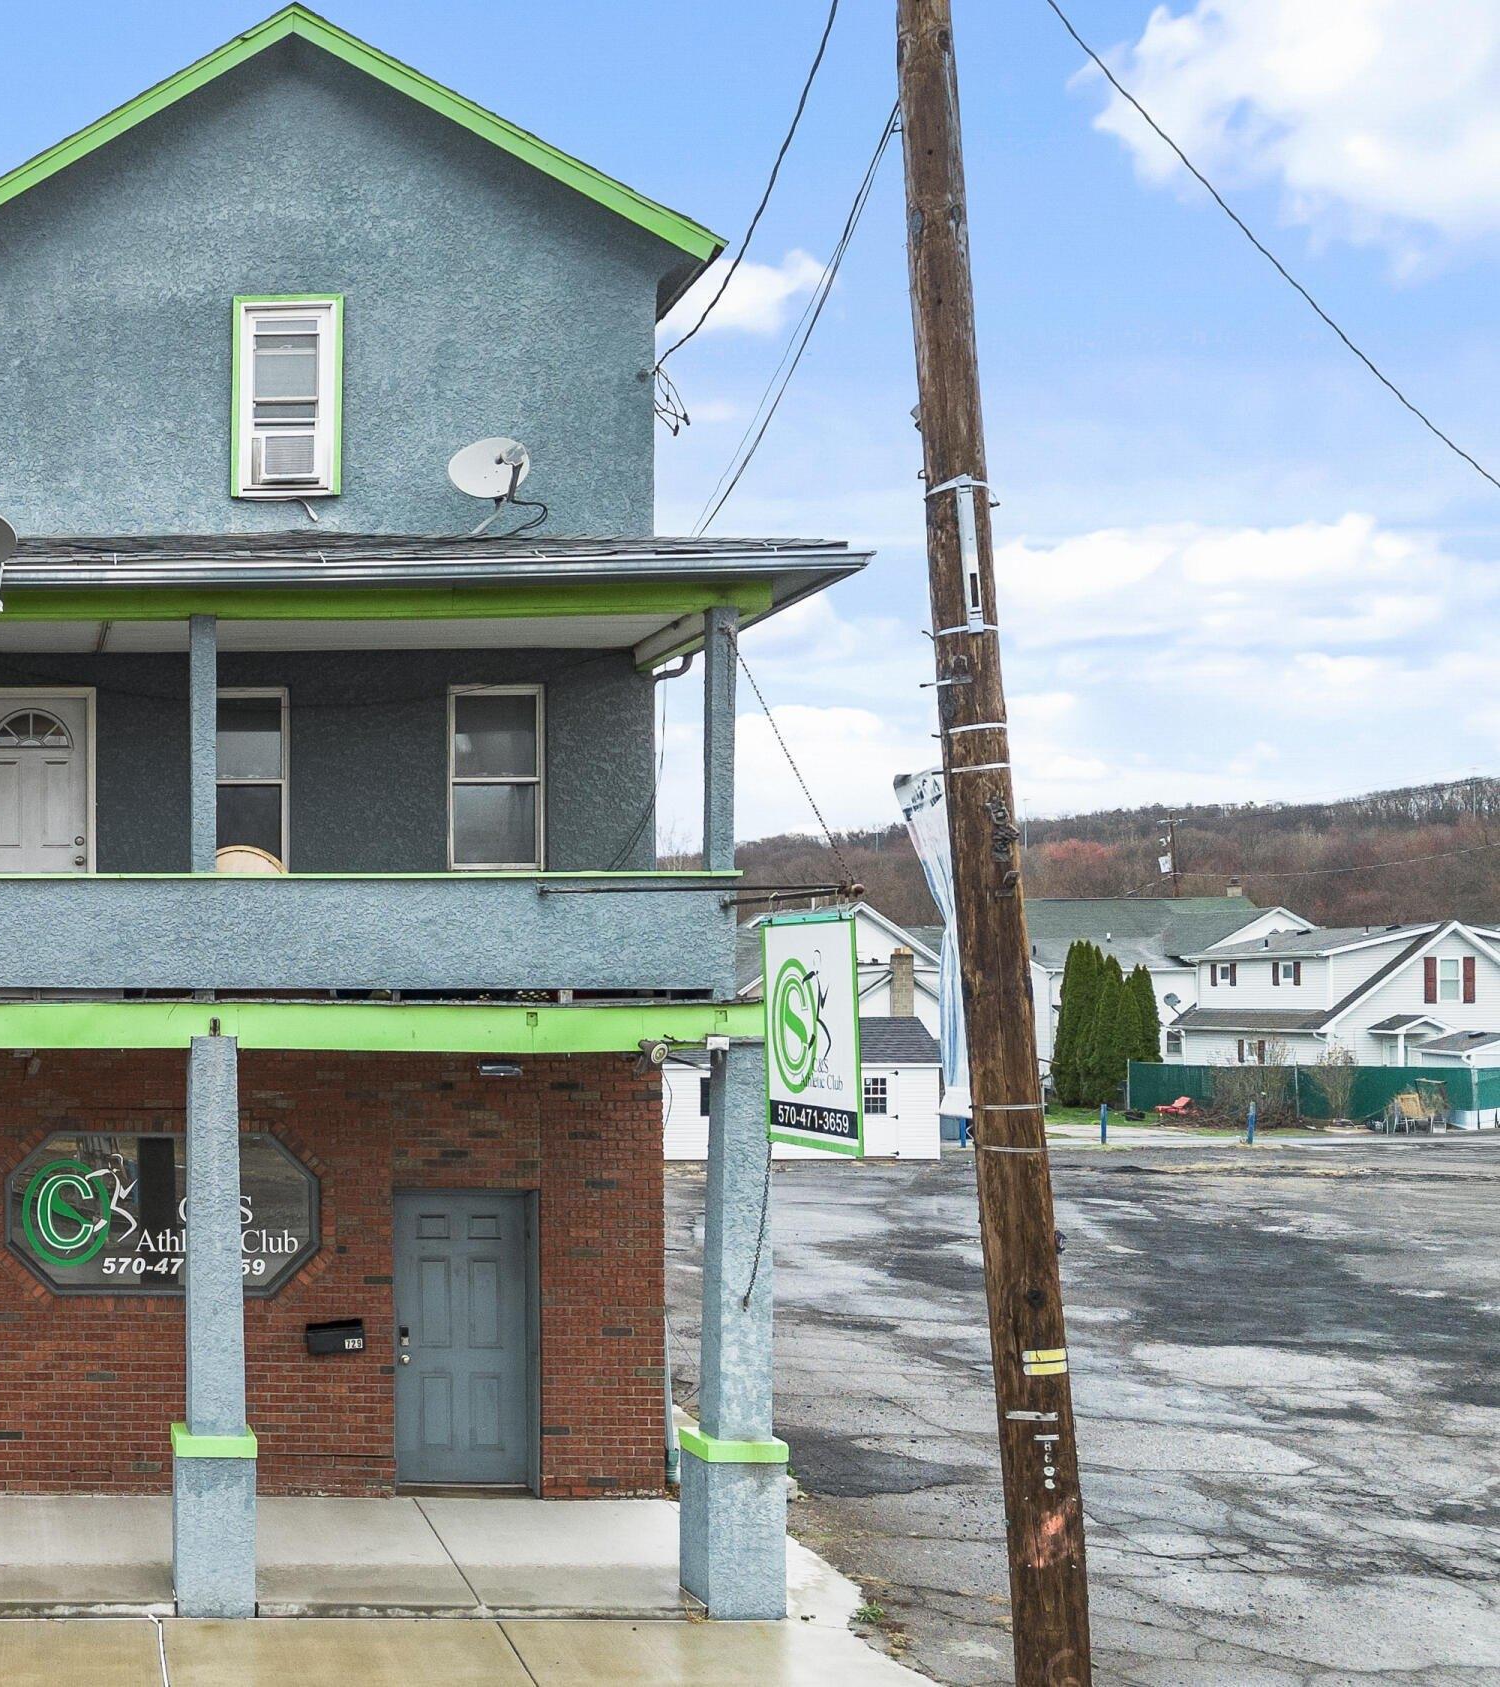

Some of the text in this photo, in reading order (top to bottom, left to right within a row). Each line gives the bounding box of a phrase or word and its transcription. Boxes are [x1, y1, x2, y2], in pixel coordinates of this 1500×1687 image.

[826, 1074, 844, 1091] Club
[778, 1105, 849, 1133] 570-471-3659
[241, 1229, 299, 1254] Club
